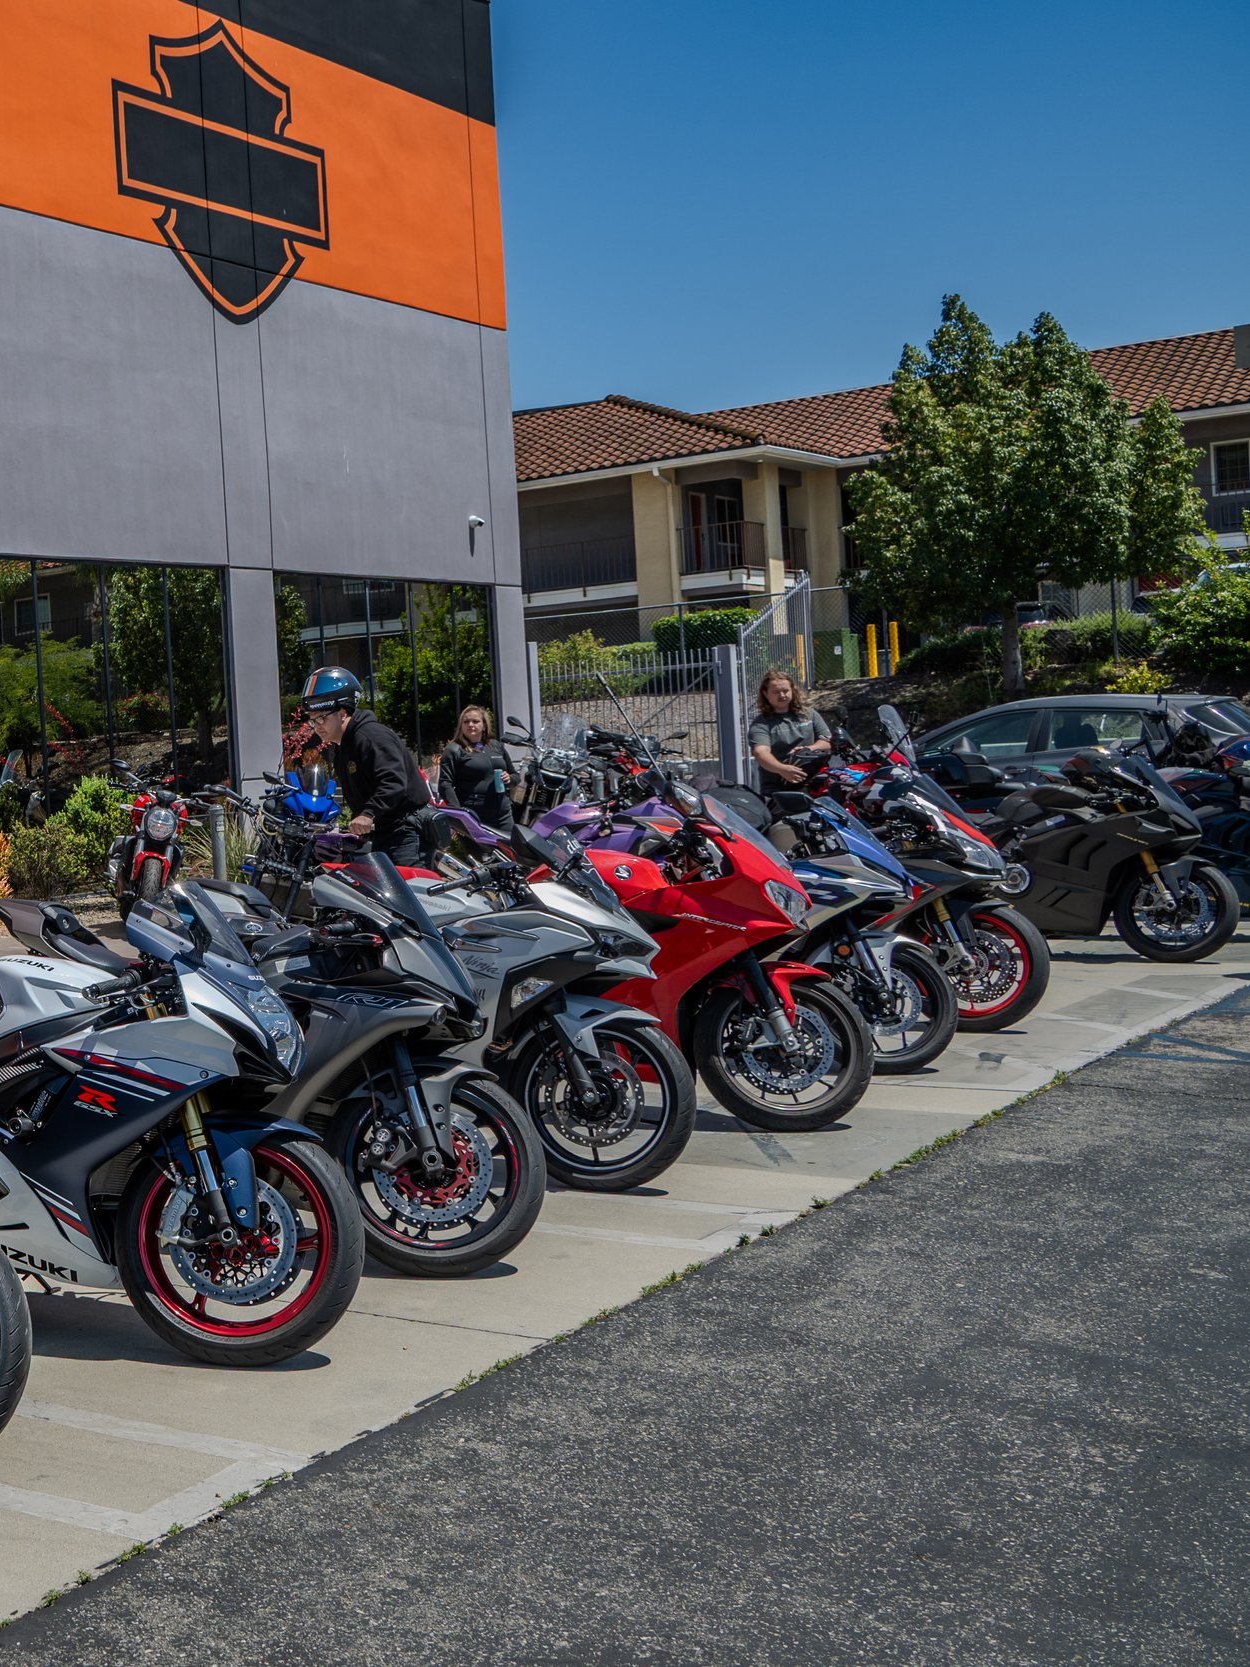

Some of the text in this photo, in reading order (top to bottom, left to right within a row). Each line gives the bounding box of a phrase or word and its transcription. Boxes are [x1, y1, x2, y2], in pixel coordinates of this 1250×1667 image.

[418, 897, 452, 911] awasaki
[462, 955, 501, 975] Ninja
[73, 1100, 118, 1118] GSX
[164, 1199, 183, 1232] brembo
[0, 1243, 79, 1283] ZUKI
